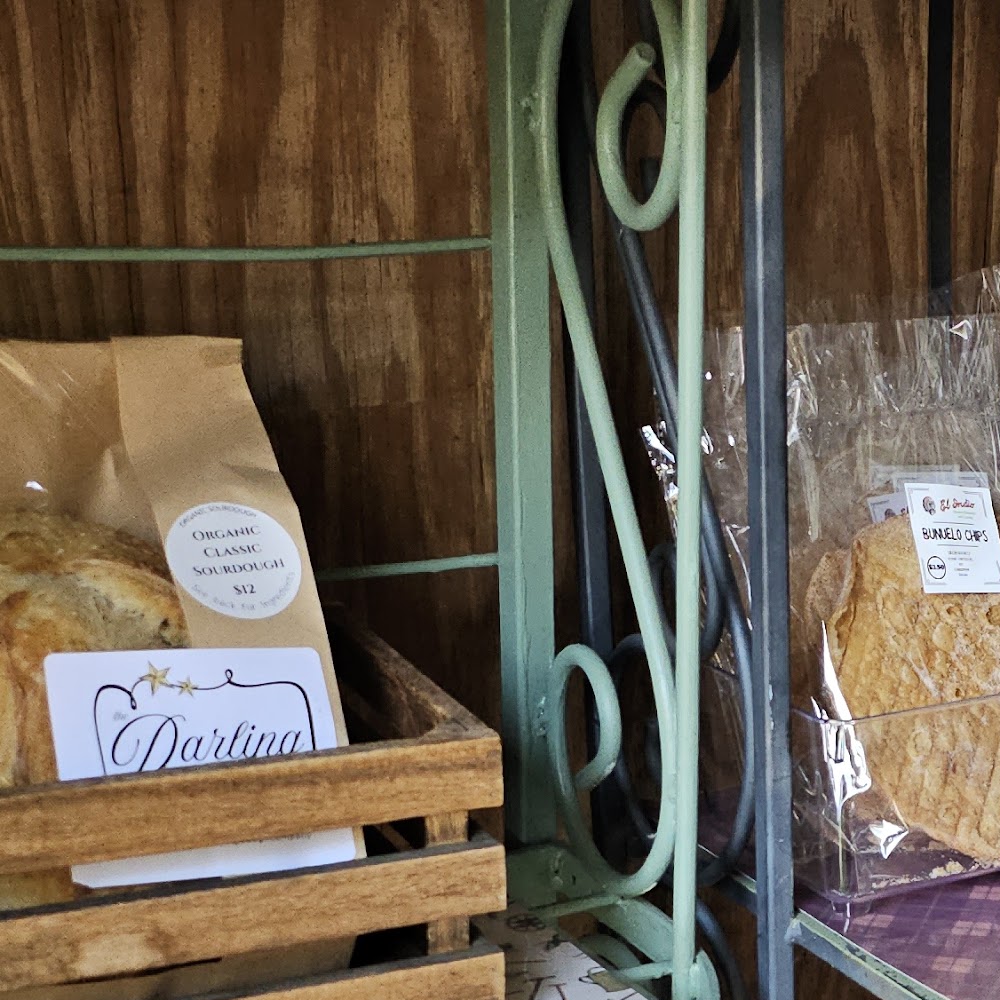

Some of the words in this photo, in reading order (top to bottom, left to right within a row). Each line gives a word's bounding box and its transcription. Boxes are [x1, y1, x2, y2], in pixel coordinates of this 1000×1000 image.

[192, 526, 262, 541] ORGANIC
[965, 529, 988, 542] CHIPS
[204, 543, 262, 558] CLASSIC
[192, 558, 285, 576] SOURDOUGH
[233, 584, 256, 595] $12
